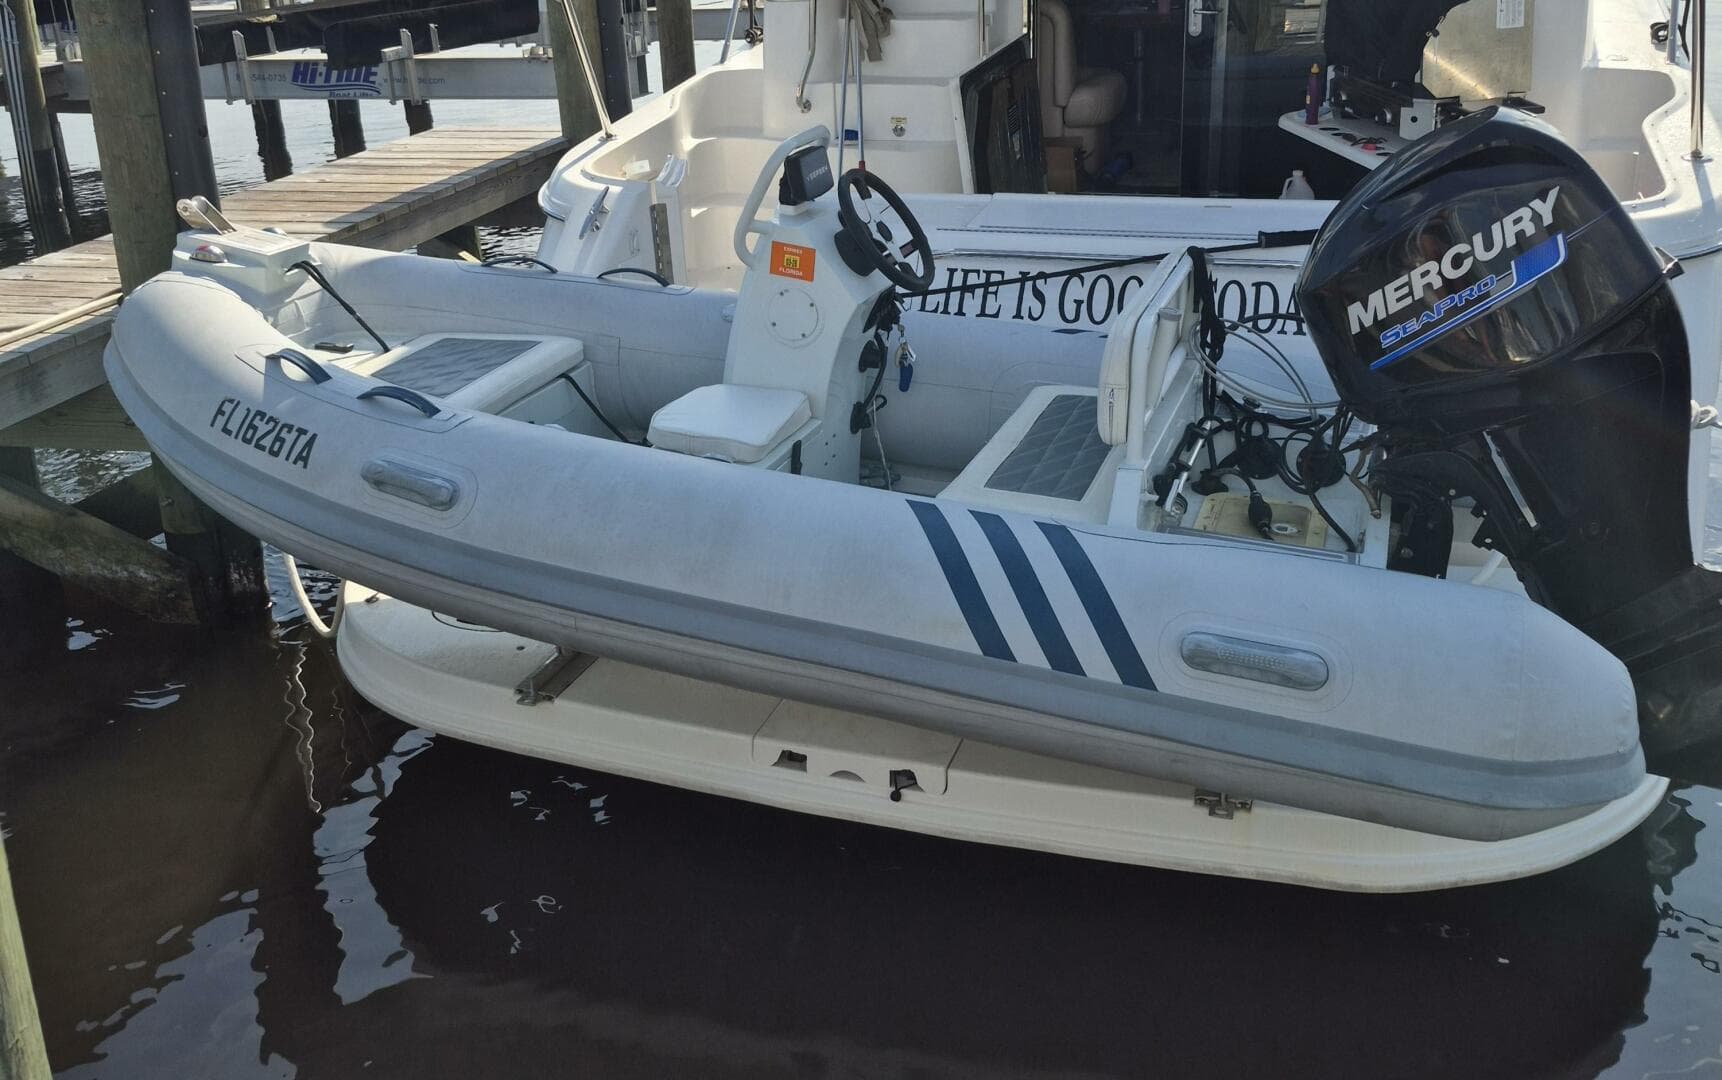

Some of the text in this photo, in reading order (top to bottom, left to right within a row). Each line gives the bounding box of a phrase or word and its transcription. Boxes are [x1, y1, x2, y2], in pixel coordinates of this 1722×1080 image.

[778, 266, 803, 276] FLORIDA
[1347, 185, 1560, 335] MERCURY
[917, 267, 1005, 318] LIFE
[1012, 271, 1048, 321] IS
[210, 398, 318, 469] FL1626TA
